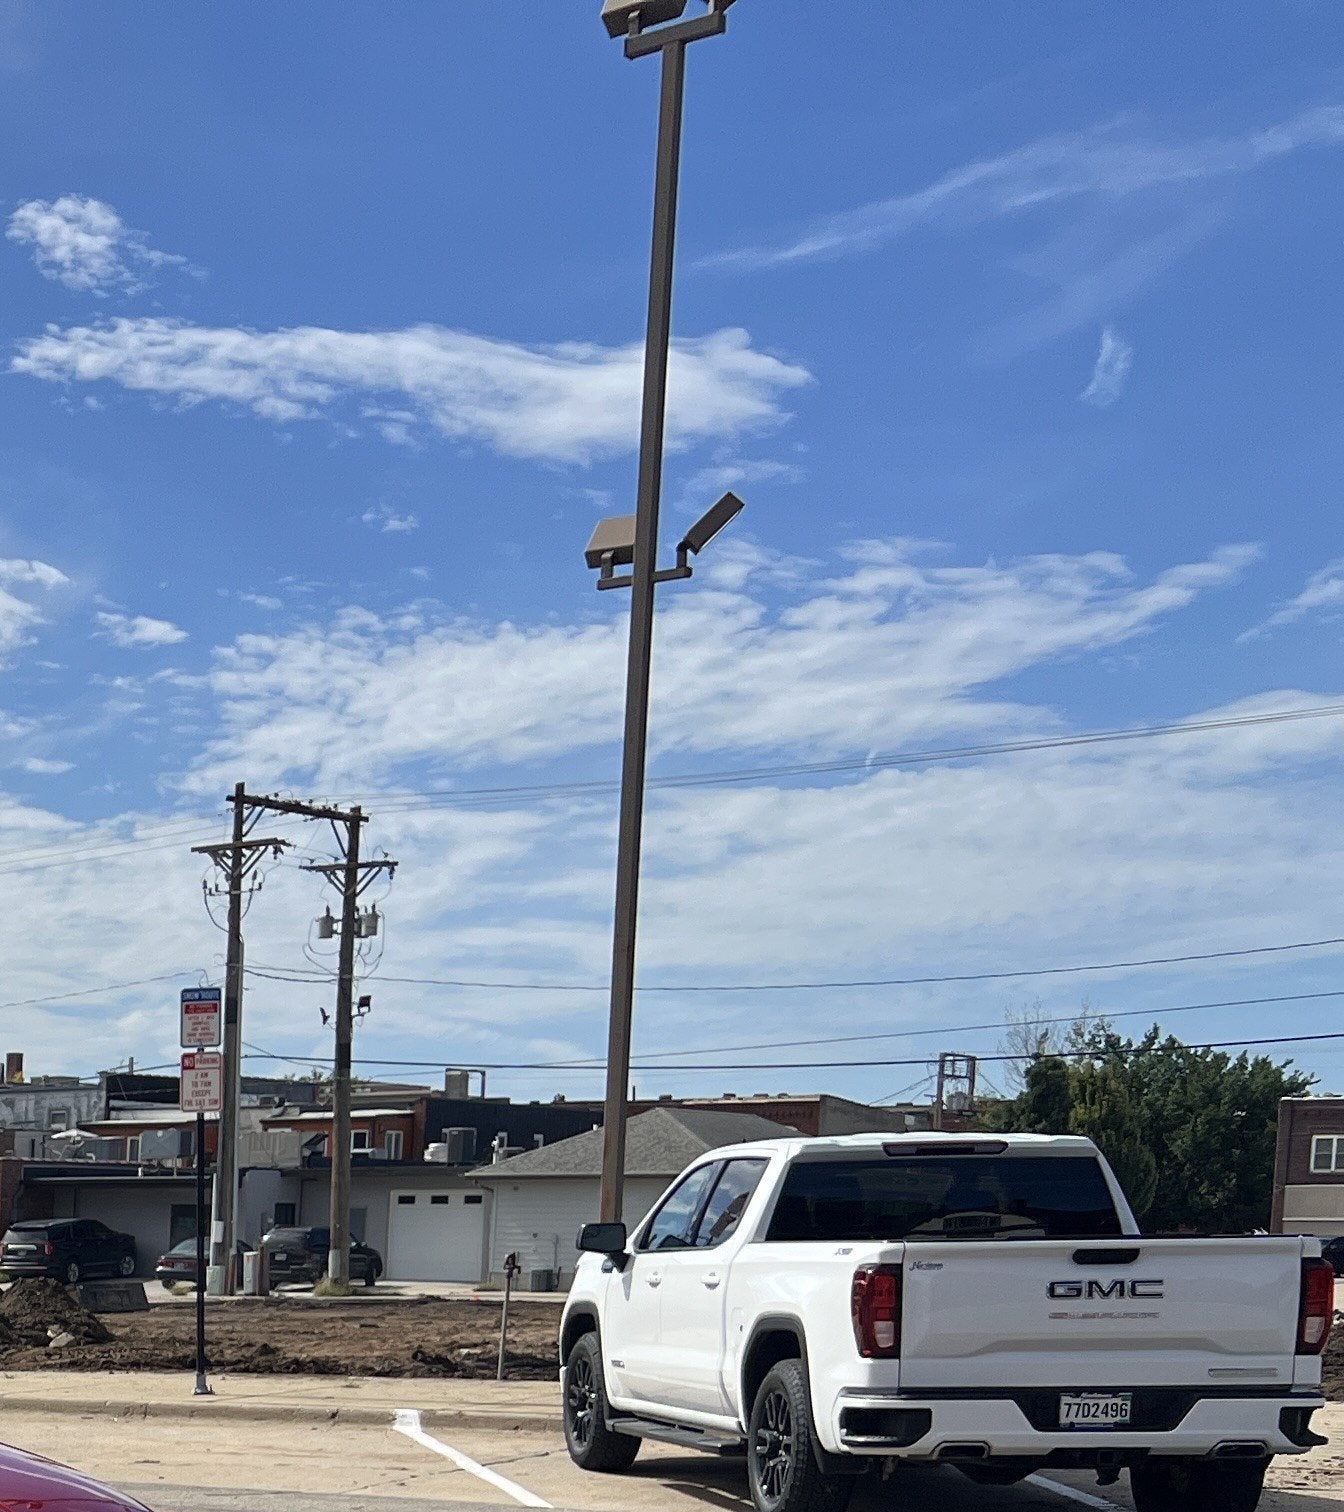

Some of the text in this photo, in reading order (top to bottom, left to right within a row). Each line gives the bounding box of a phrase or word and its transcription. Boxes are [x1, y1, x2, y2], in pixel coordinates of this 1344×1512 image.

[183, 1057, 219, 1067] NO PARKING
[191, 1089, 211, 1098] EXCEPT
[1047, 1280, 1163, 1299] GMC
[1064, 1402, 1128, 1419] 77D2496
